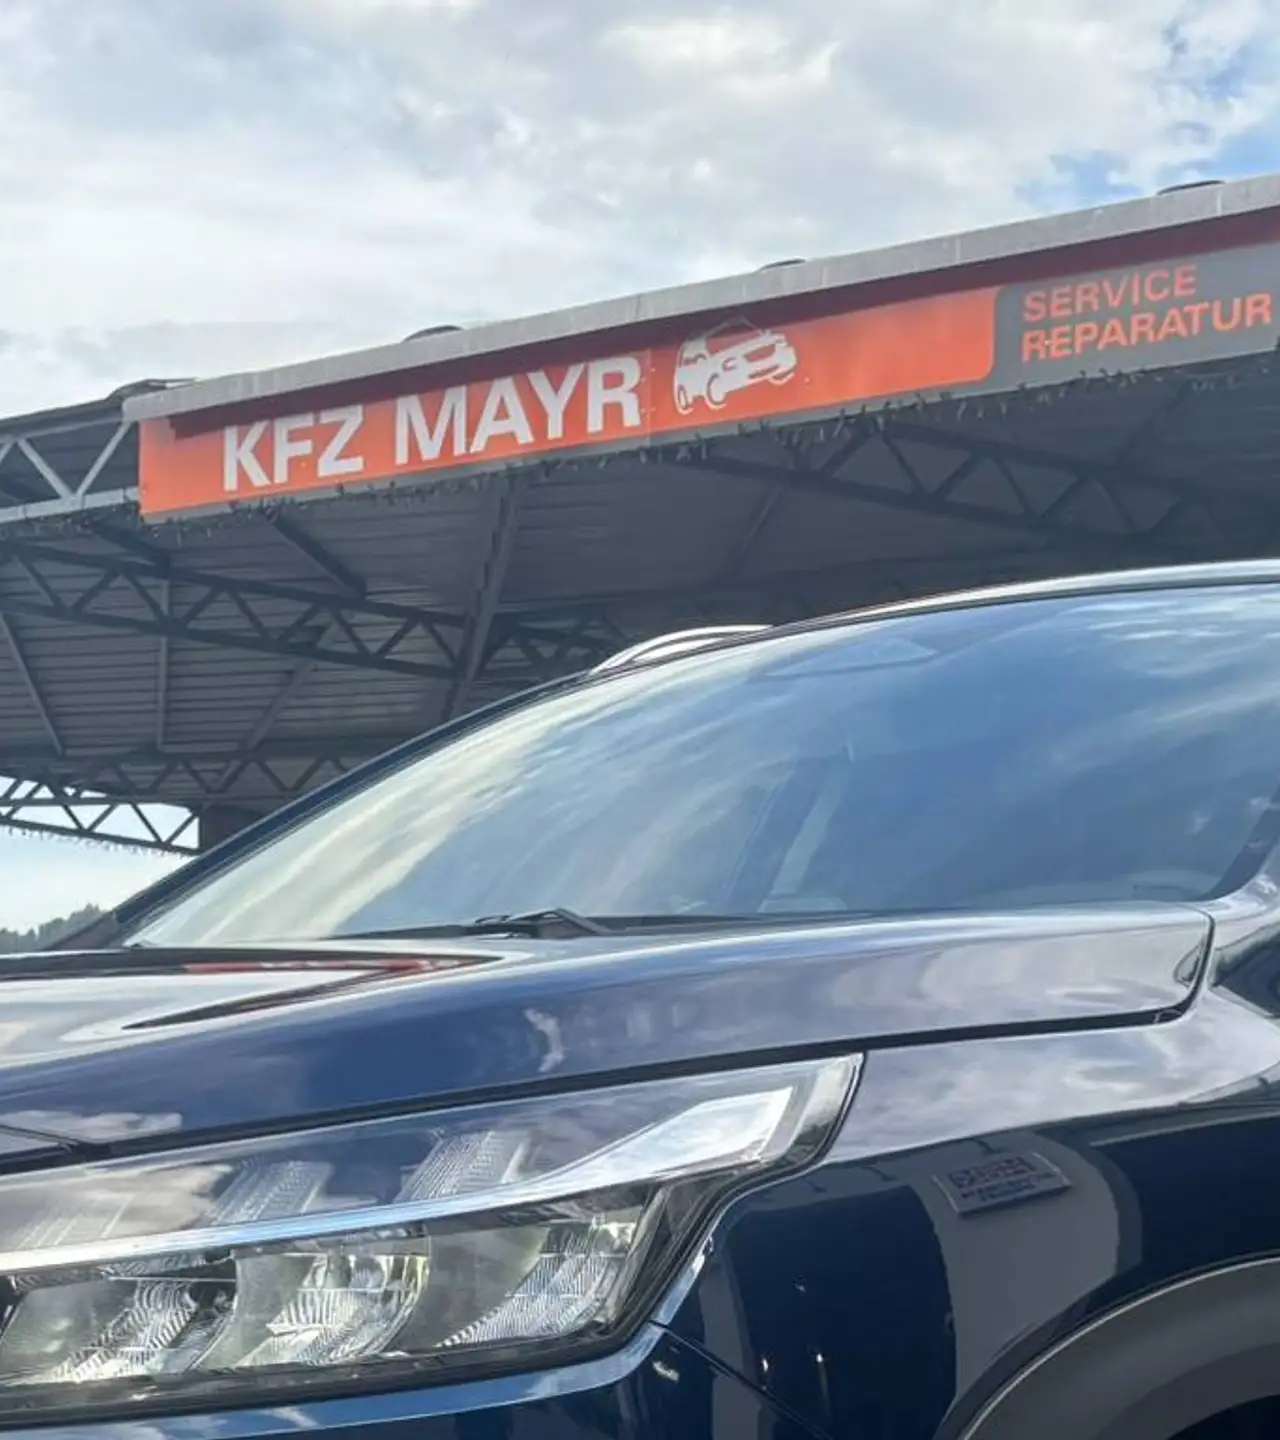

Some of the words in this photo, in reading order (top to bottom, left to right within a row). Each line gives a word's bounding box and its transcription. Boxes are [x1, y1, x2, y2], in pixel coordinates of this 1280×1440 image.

[1022, 293, 1271, 362] REPARATUR
[1024, 265, 1197, 323] SERVICE
[223, 405, 365, 492] KFZ
[396, 356, 641, 467] MAYR
